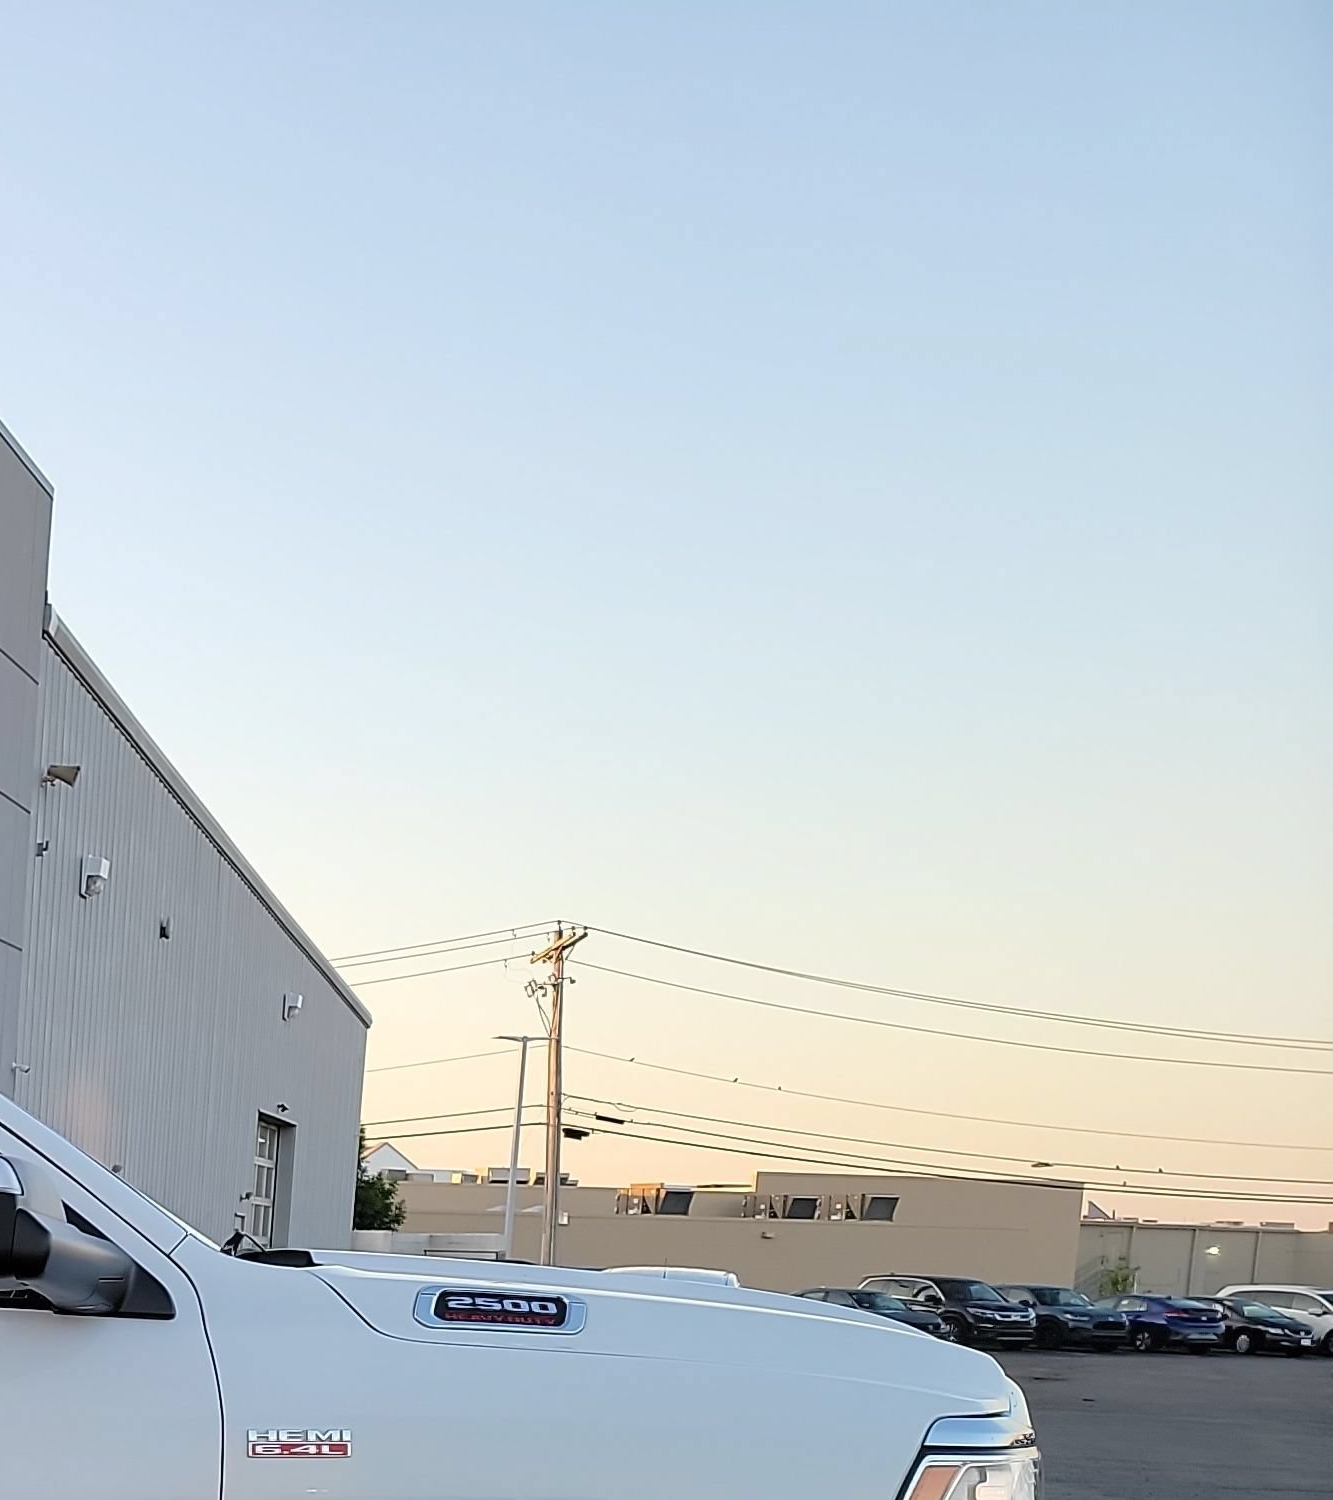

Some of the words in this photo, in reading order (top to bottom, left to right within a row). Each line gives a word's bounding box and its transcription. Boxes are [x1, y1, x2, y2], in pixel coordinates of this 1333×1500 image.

[446, 1297, 558, 1314] 2500
[444, 1313, 505, 1323] HEAVY
[247, 1428, 352, 1442] HEMI
[254, 1444, 345, 1455] 6.4L
